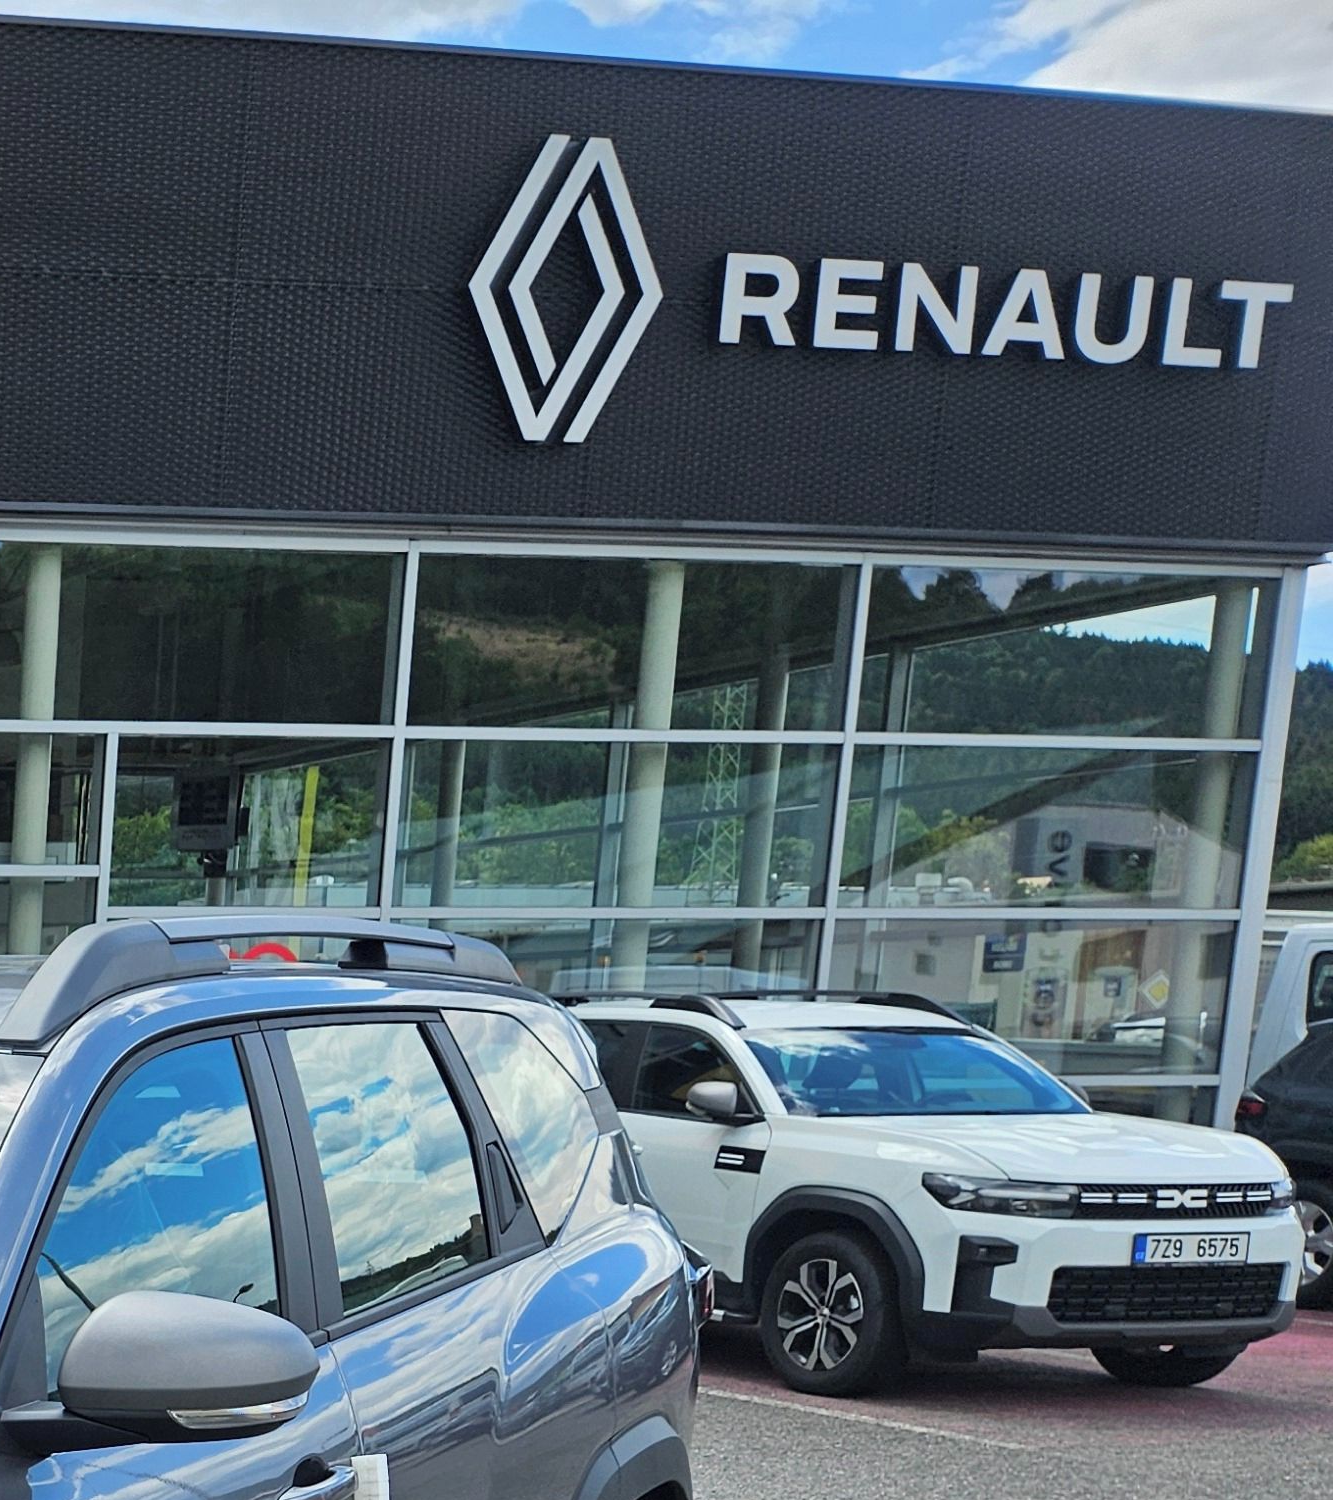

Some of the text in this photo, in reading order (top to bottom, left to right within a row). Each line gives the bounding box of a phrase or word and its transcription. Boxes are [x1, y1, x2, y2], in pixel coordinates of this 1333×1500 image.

[718, 252, 1295, 370] RENAULT
[1150, 1239, 1183, 1259] 7Z9
[1197, 1238, 1240, 1257] 6575
